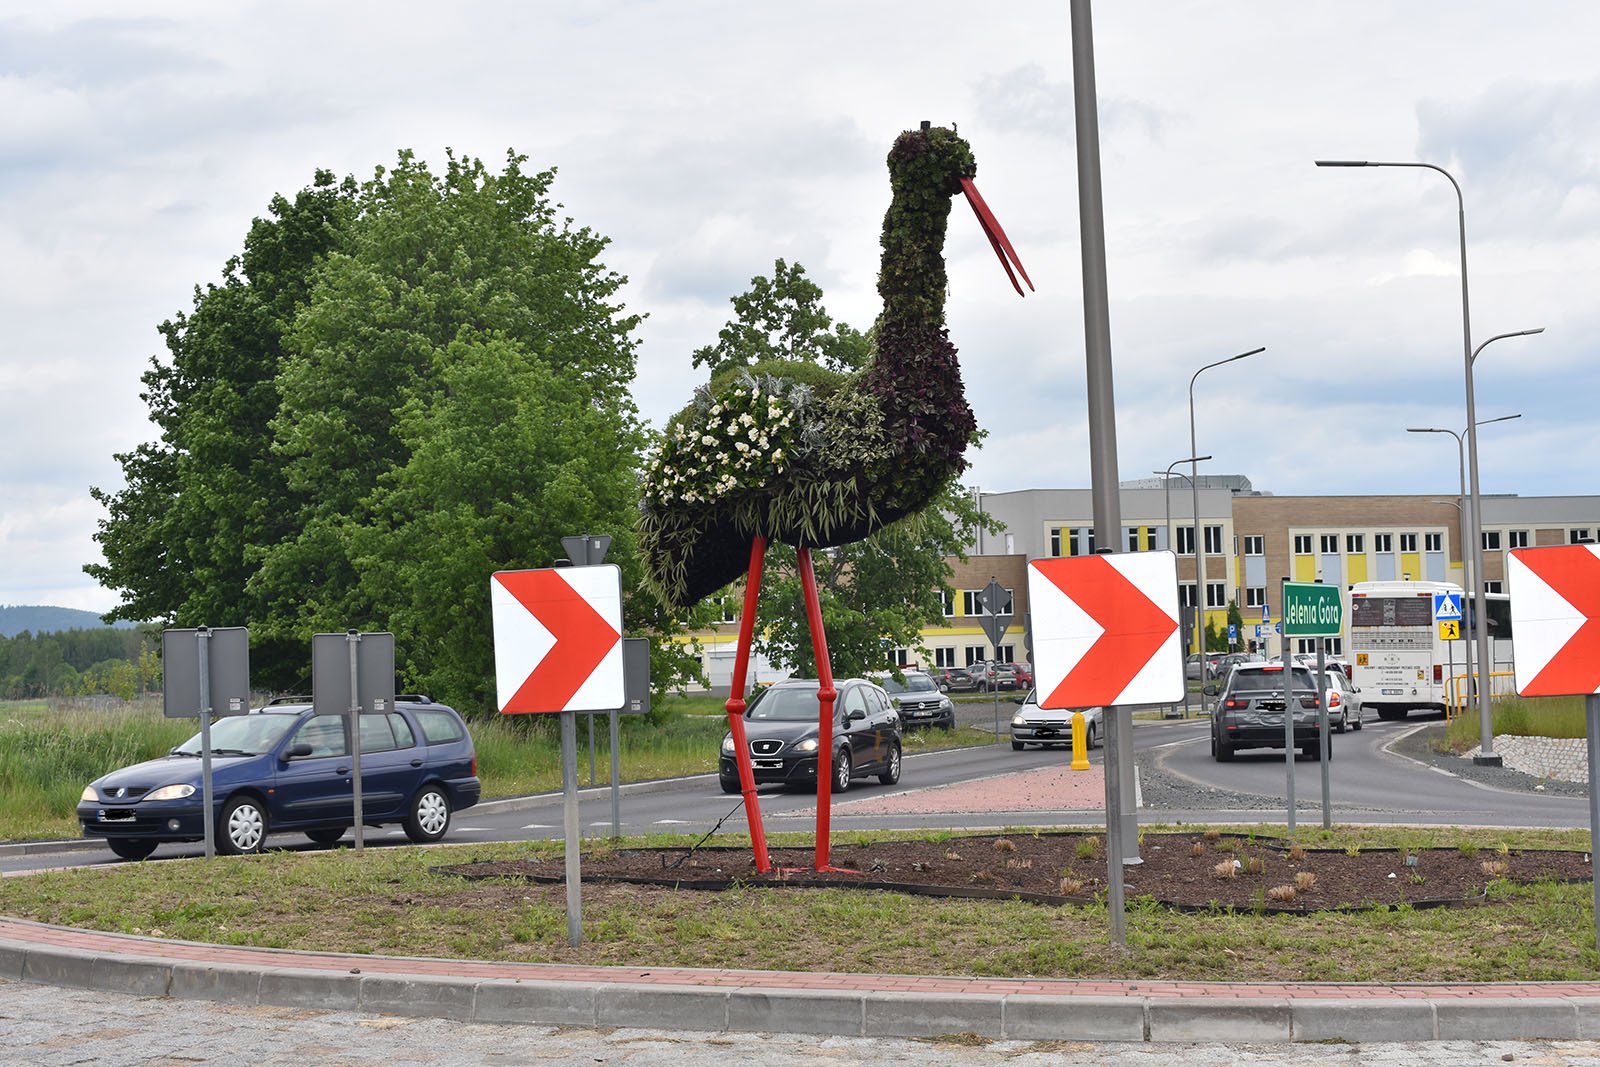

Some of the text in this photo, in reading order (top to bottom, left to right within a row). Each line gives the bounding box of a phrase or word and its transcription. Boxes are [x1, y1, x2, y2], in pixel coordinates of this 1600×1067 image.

[1286, 595, 1317, 625] Jelenia
[1318, 595, 1339, 625] Góra
[1229, 625, 1235, 634] P
